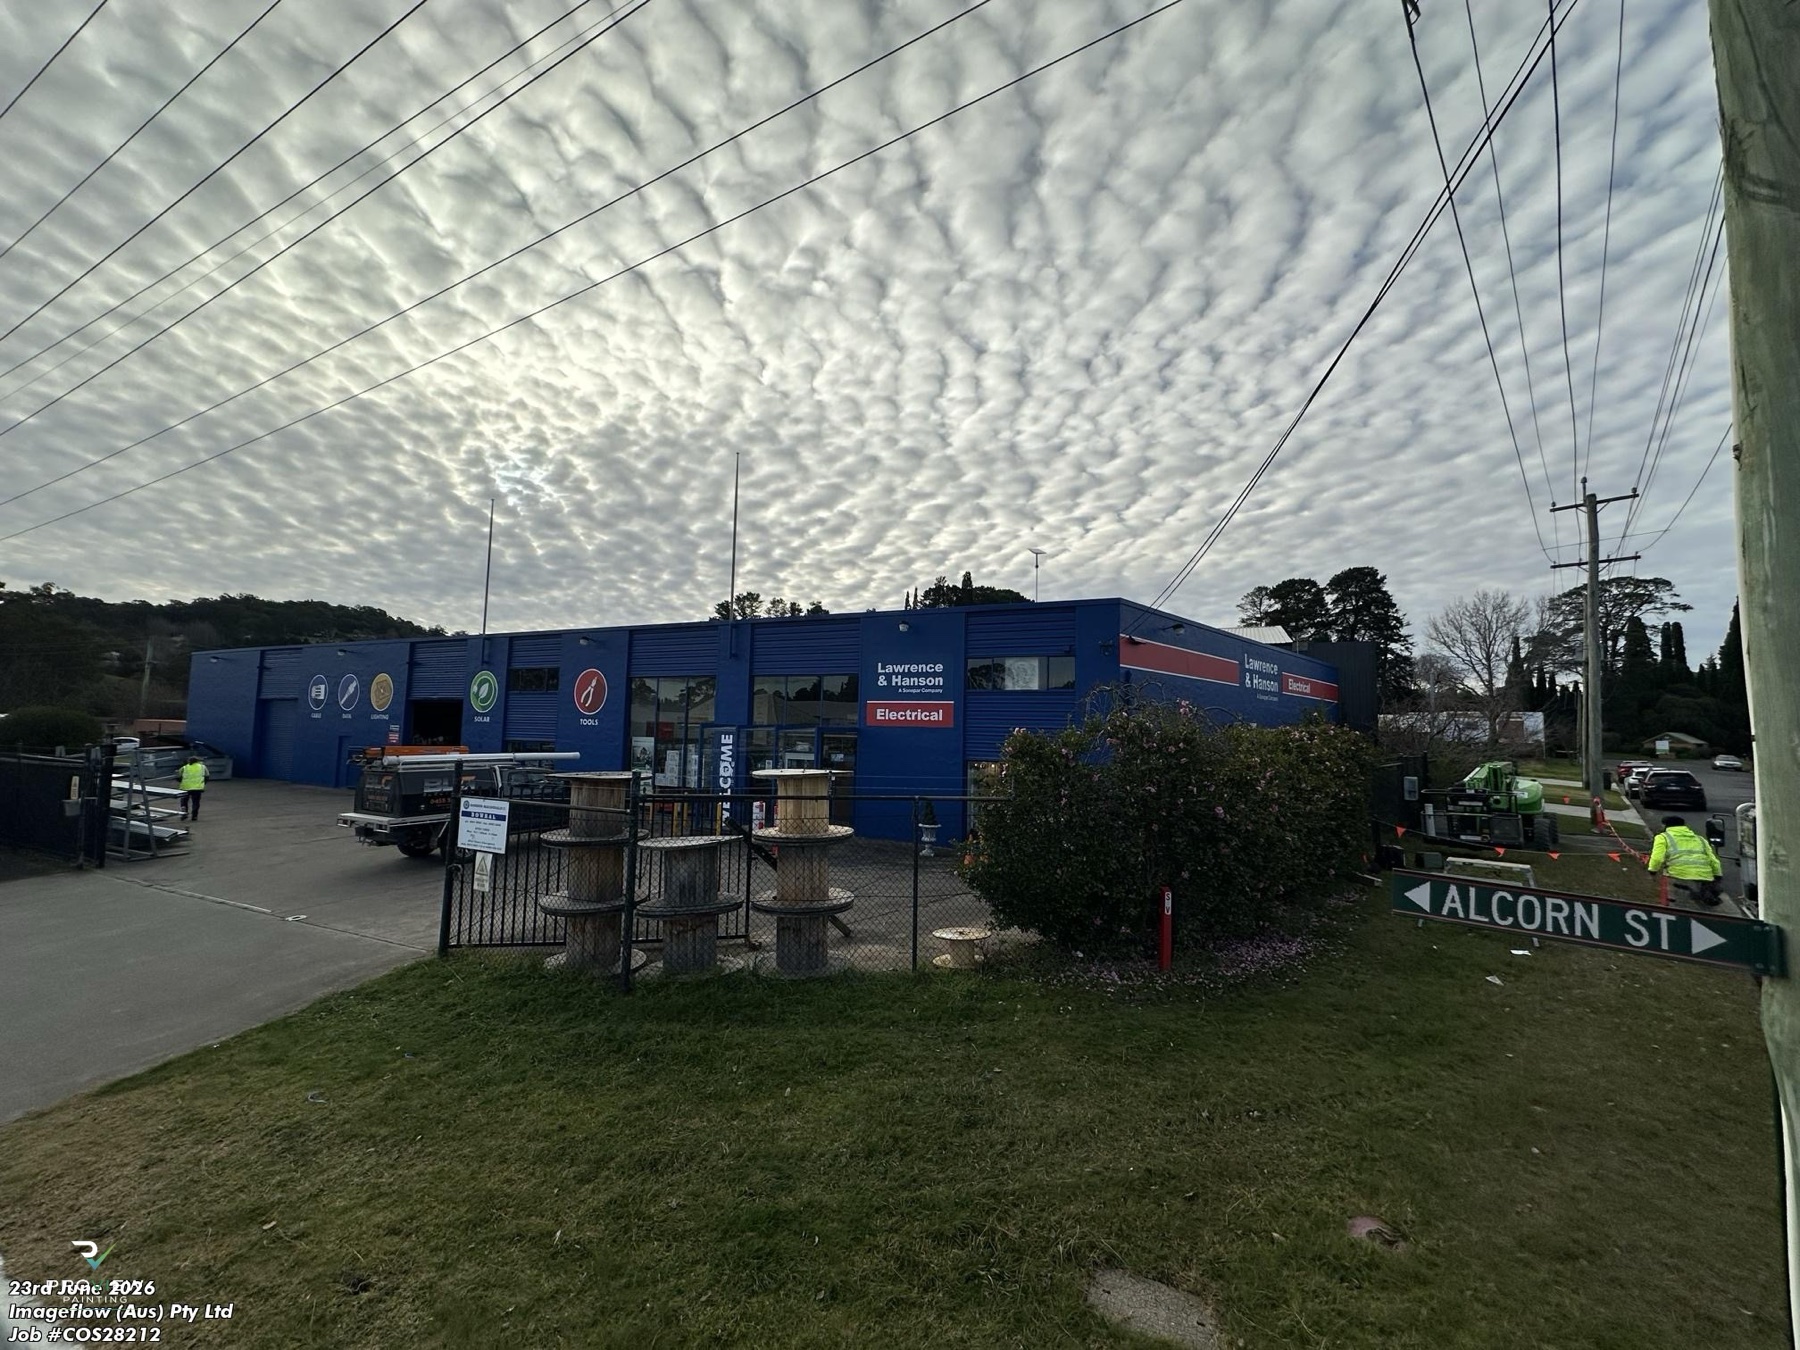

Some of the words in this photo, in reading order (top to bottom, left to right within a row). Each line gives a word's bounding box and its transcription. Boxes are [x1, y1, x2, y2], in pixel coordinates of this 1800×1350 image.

[877, 662, 943, 673] Lawrence
[1244, 653, 1278, 675] Lawrence
[877, 675, 888, 686] &
[891, 675, 943, 686] Hanson
[1245, 672, 1251, 688] &
[1253, 673, 1279, 692] Hanson
[1288, 678, 1311, 693] Electrical
[876, 708, 943, 721] Electrical
[579, 718, 599, 726] TOOLS
[1441, 884, 1600, 940] ALCORN
[1624, 908, 1677, 950] ST
